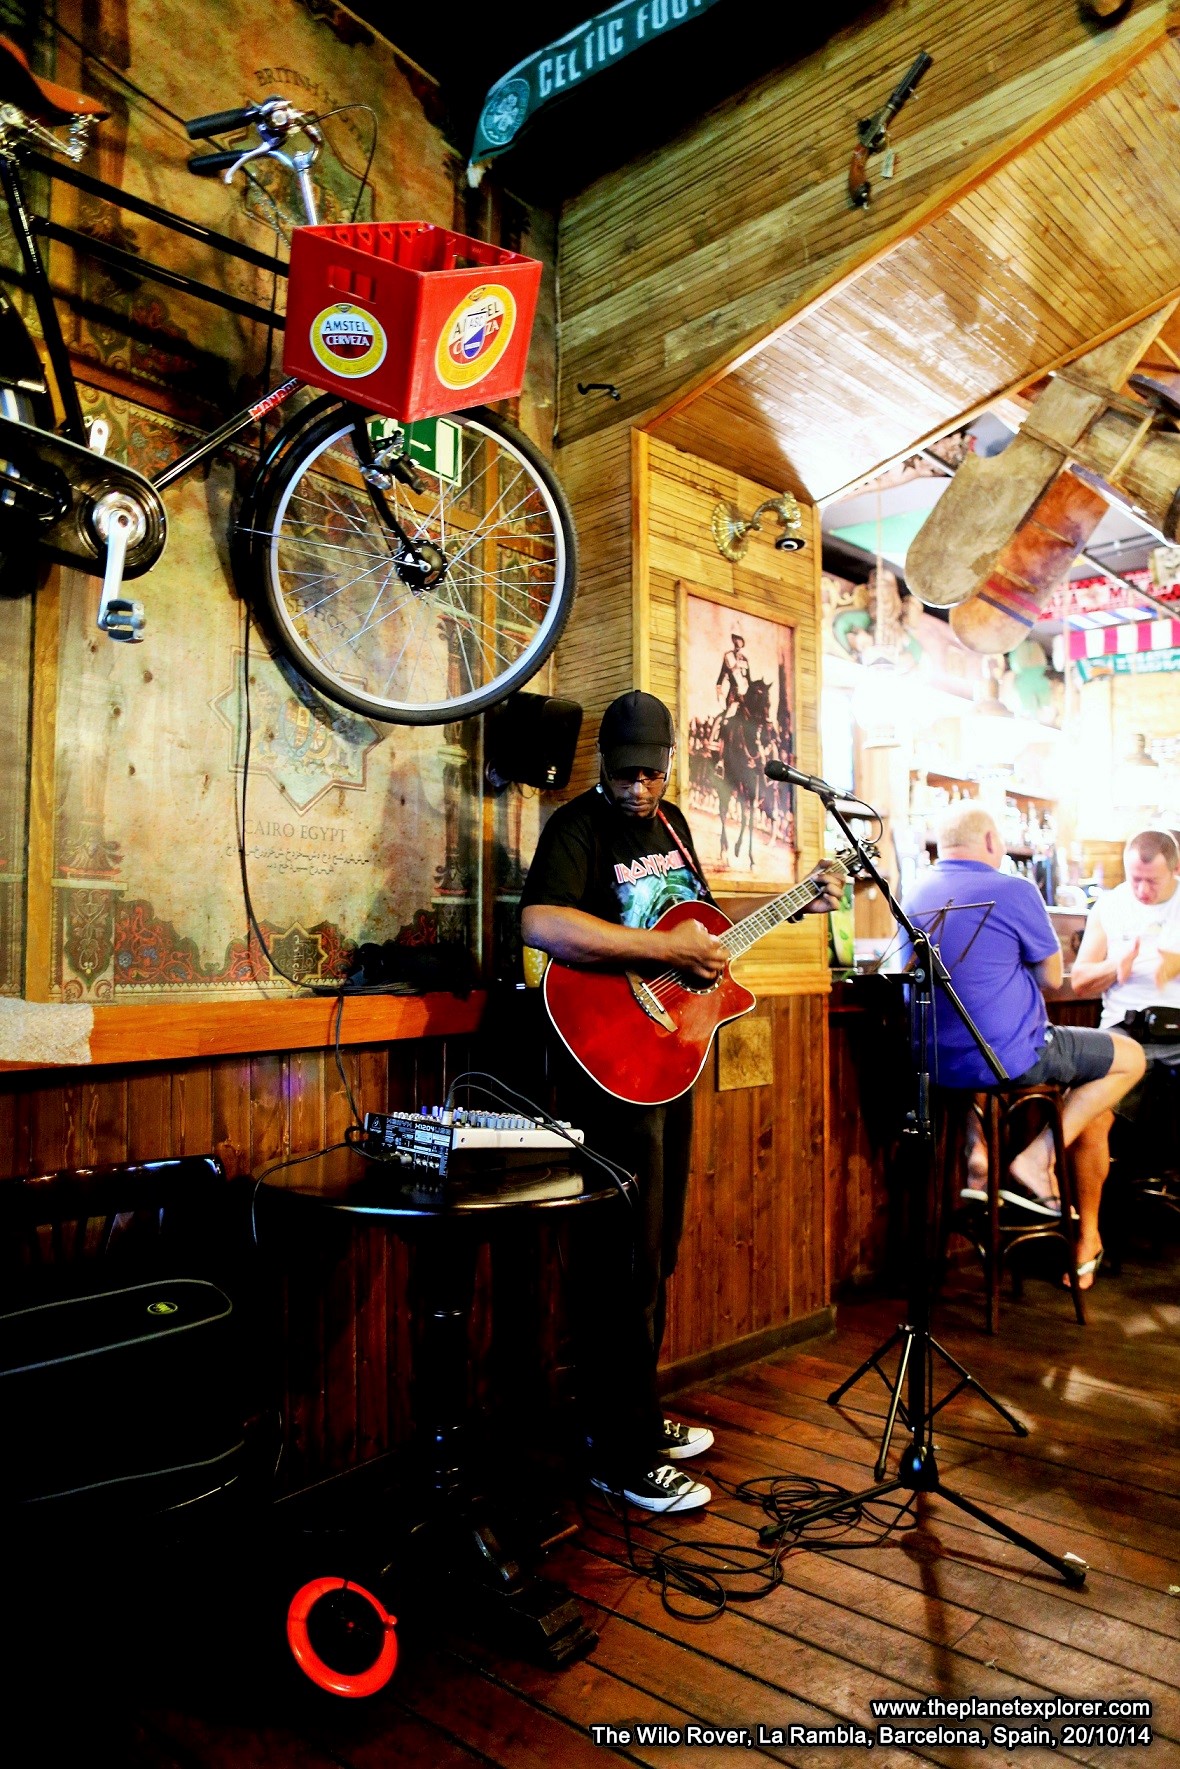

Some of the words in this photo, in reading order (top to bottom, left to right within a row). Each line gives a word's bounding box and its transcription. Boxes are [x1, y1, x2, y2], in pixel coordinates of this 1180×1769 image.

[538, 18, 625, 98] CELTIC
[637, 0, 702, 39] FOO
[324, 320, 369, 333] AMSTEL
[325, 334, 371, 347] CERVEZA
[300, 824, 348, 843] EGYPT
[613, 854, 661, 885] IRON
